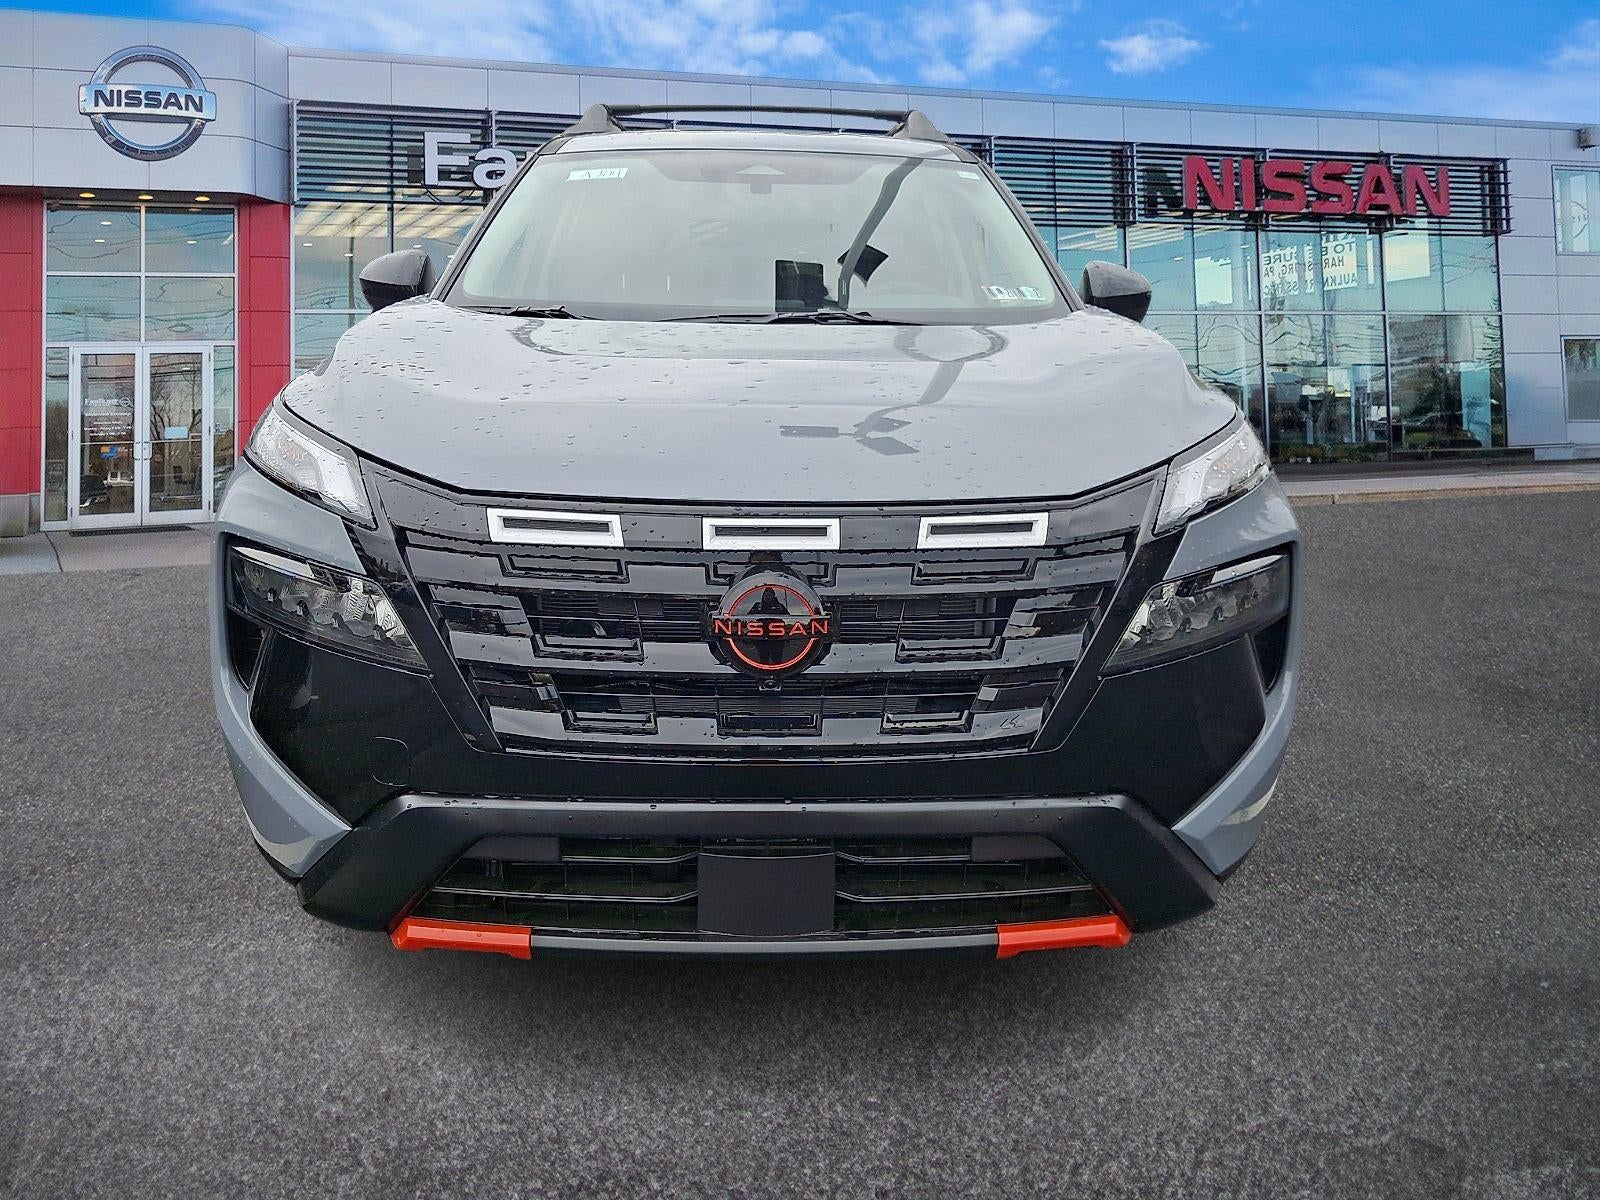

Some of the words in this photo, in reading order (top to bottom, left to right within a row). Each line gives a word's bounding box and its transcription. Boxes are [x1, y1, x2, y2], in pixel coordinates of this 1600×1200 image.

[93, 89, 204, 113] NISSAN
[424, 132, 518, 189] Fa
[1182, 155, 1451, 216] NISSAN
[713, 619, 830, 637] NISSAN
